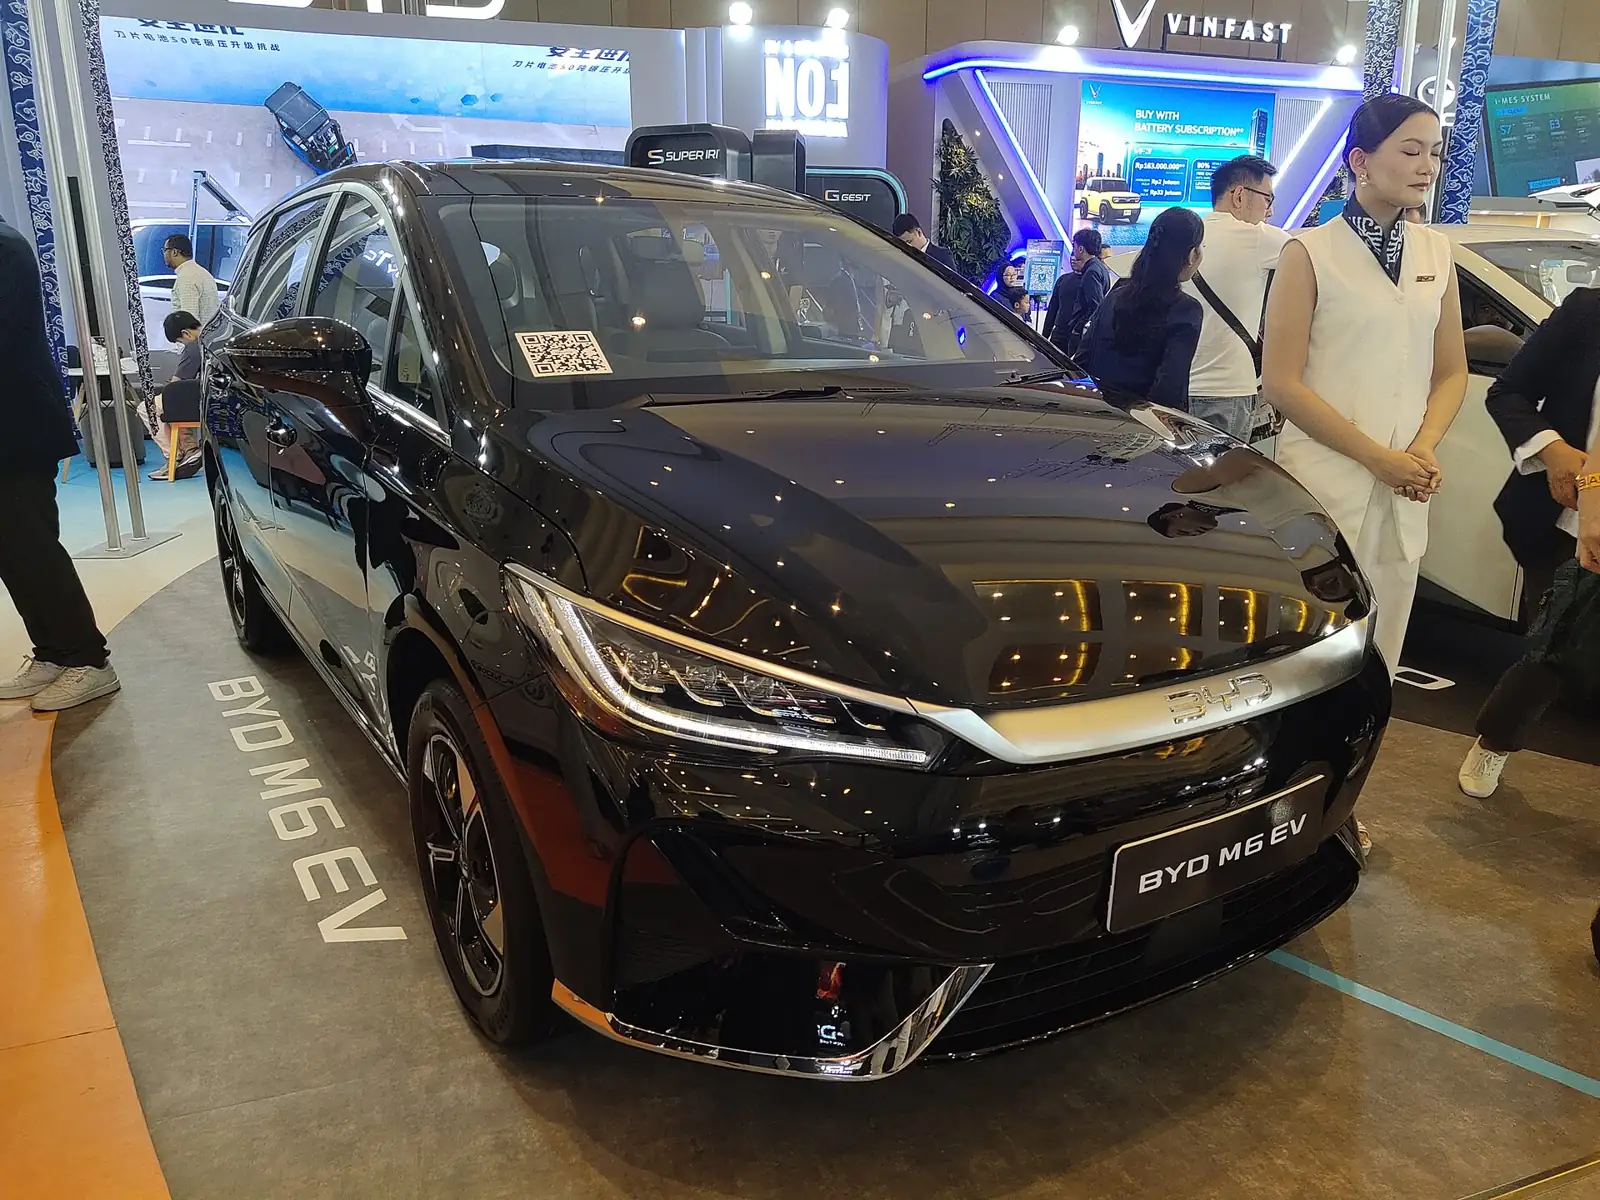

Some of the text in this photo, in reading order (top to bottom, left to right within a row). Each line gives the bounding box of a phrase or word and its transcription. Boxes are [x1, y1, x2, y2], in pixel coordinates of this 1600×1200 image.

[1167, 12, 1293, 44] VINFAST
[1520, 93, 1551, 104] SYSTEM
[1135, 109, 1180, 121] BUY WITH
[1134, 122, 1175, 134] BATTERY
[665, 150, 704, 162] SUPER
[841, 193, 871, 202] GESIT
[1165, 672, 1273, 725] BYD
[207, 675, 408, 943] BYD M6 EV
[1138, 813, 1308, 894] BYD M6 EV
